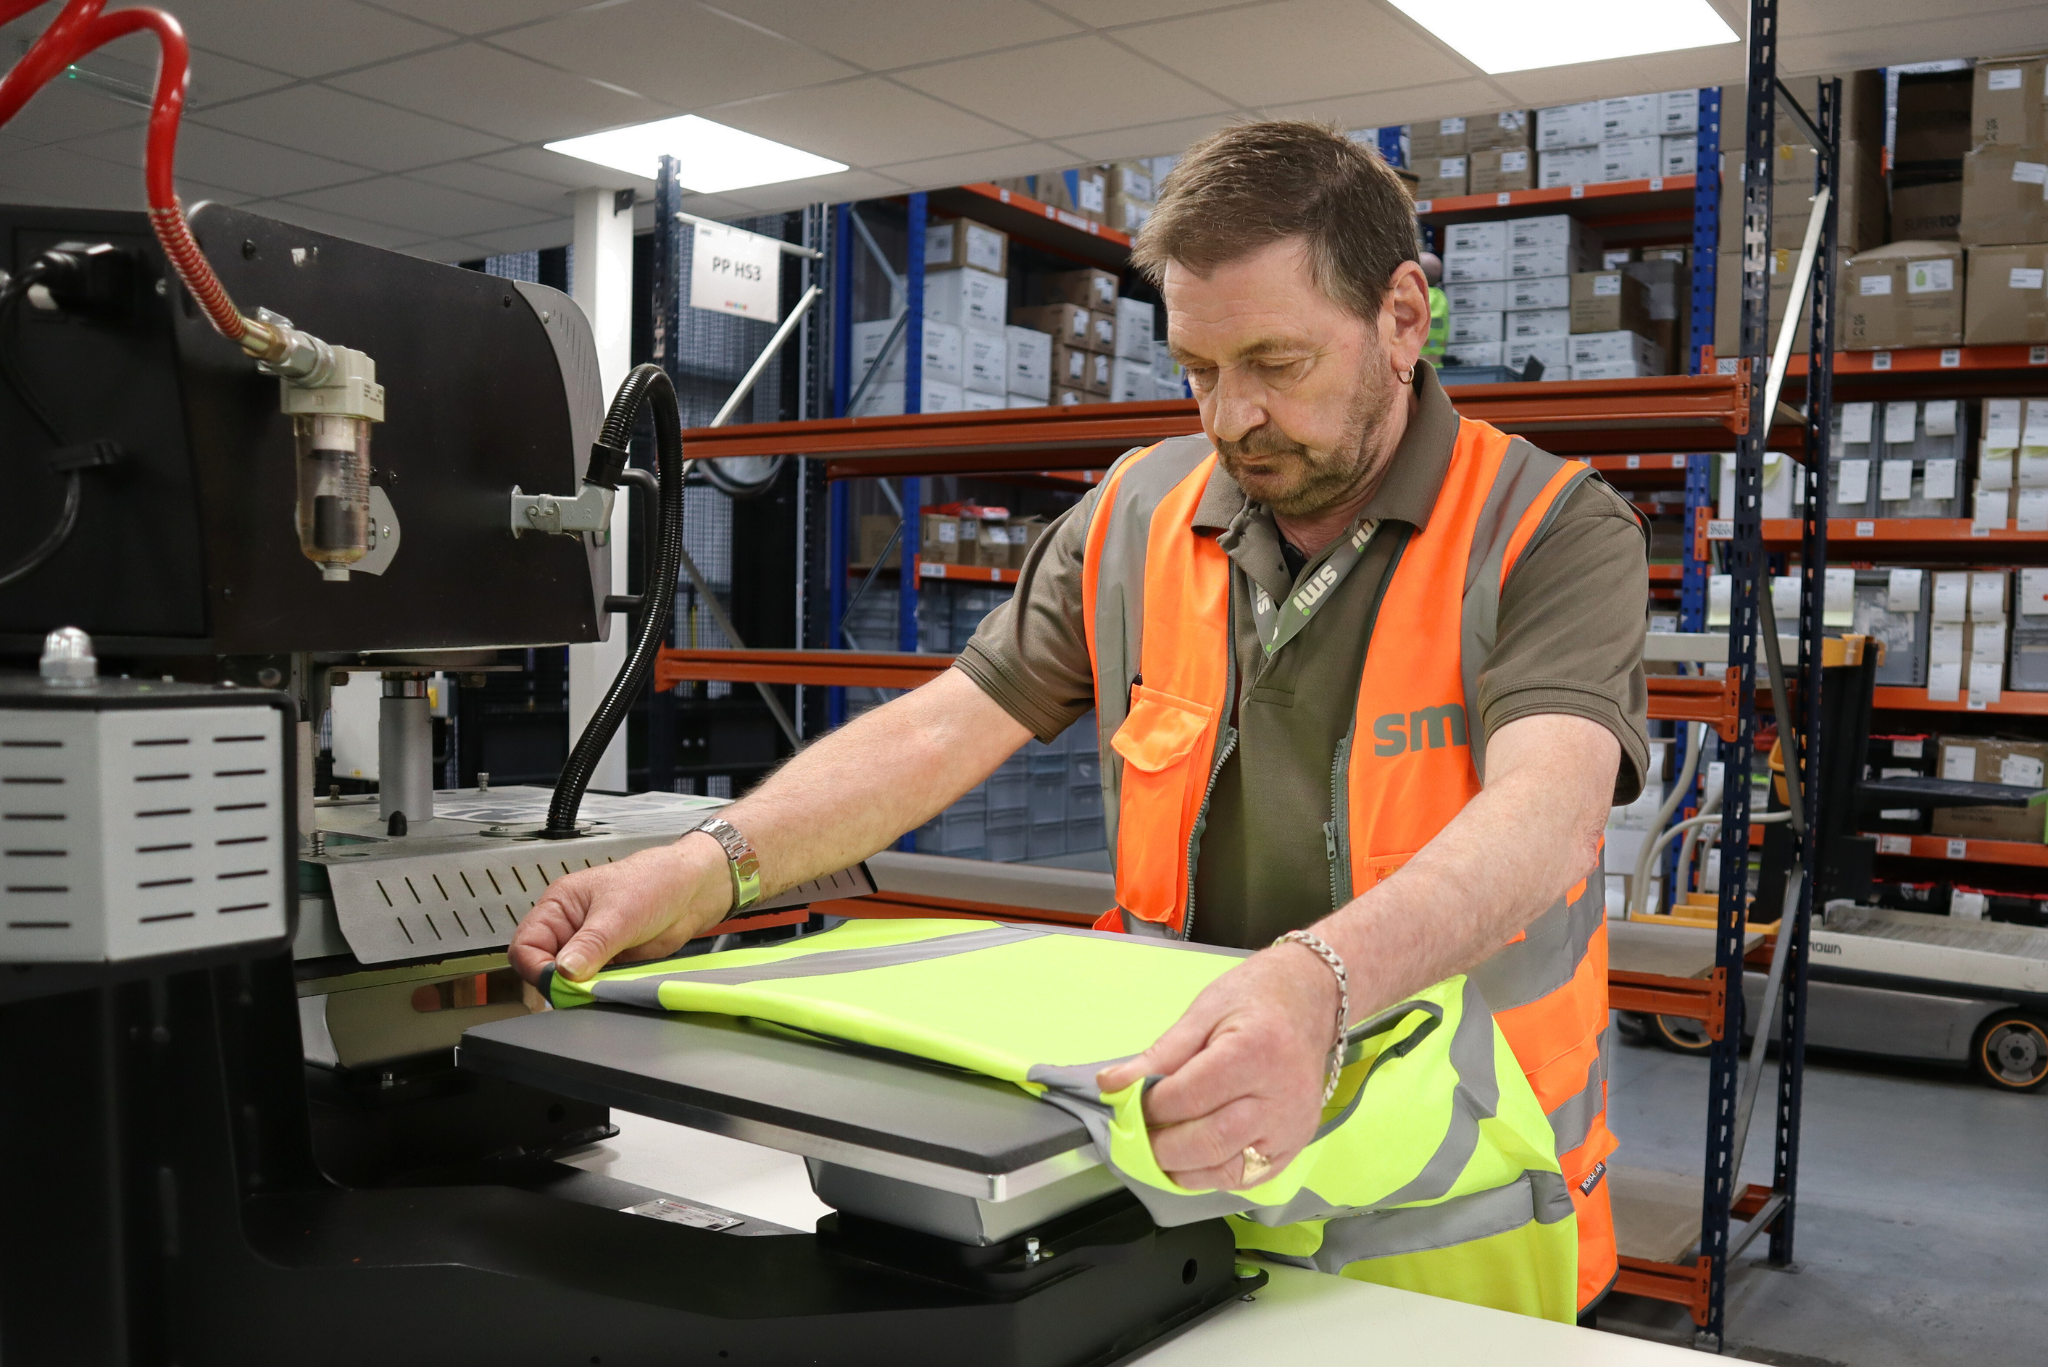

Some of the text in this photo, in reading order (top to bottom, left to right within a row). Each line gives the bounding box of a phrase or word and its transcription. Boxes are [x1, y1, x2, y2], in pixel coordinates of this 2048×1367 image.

[712, 256, 762, 281] PP HS3
[1351, 519, 1381, 554] mi
[1293, 564, 1338, 616] smi
